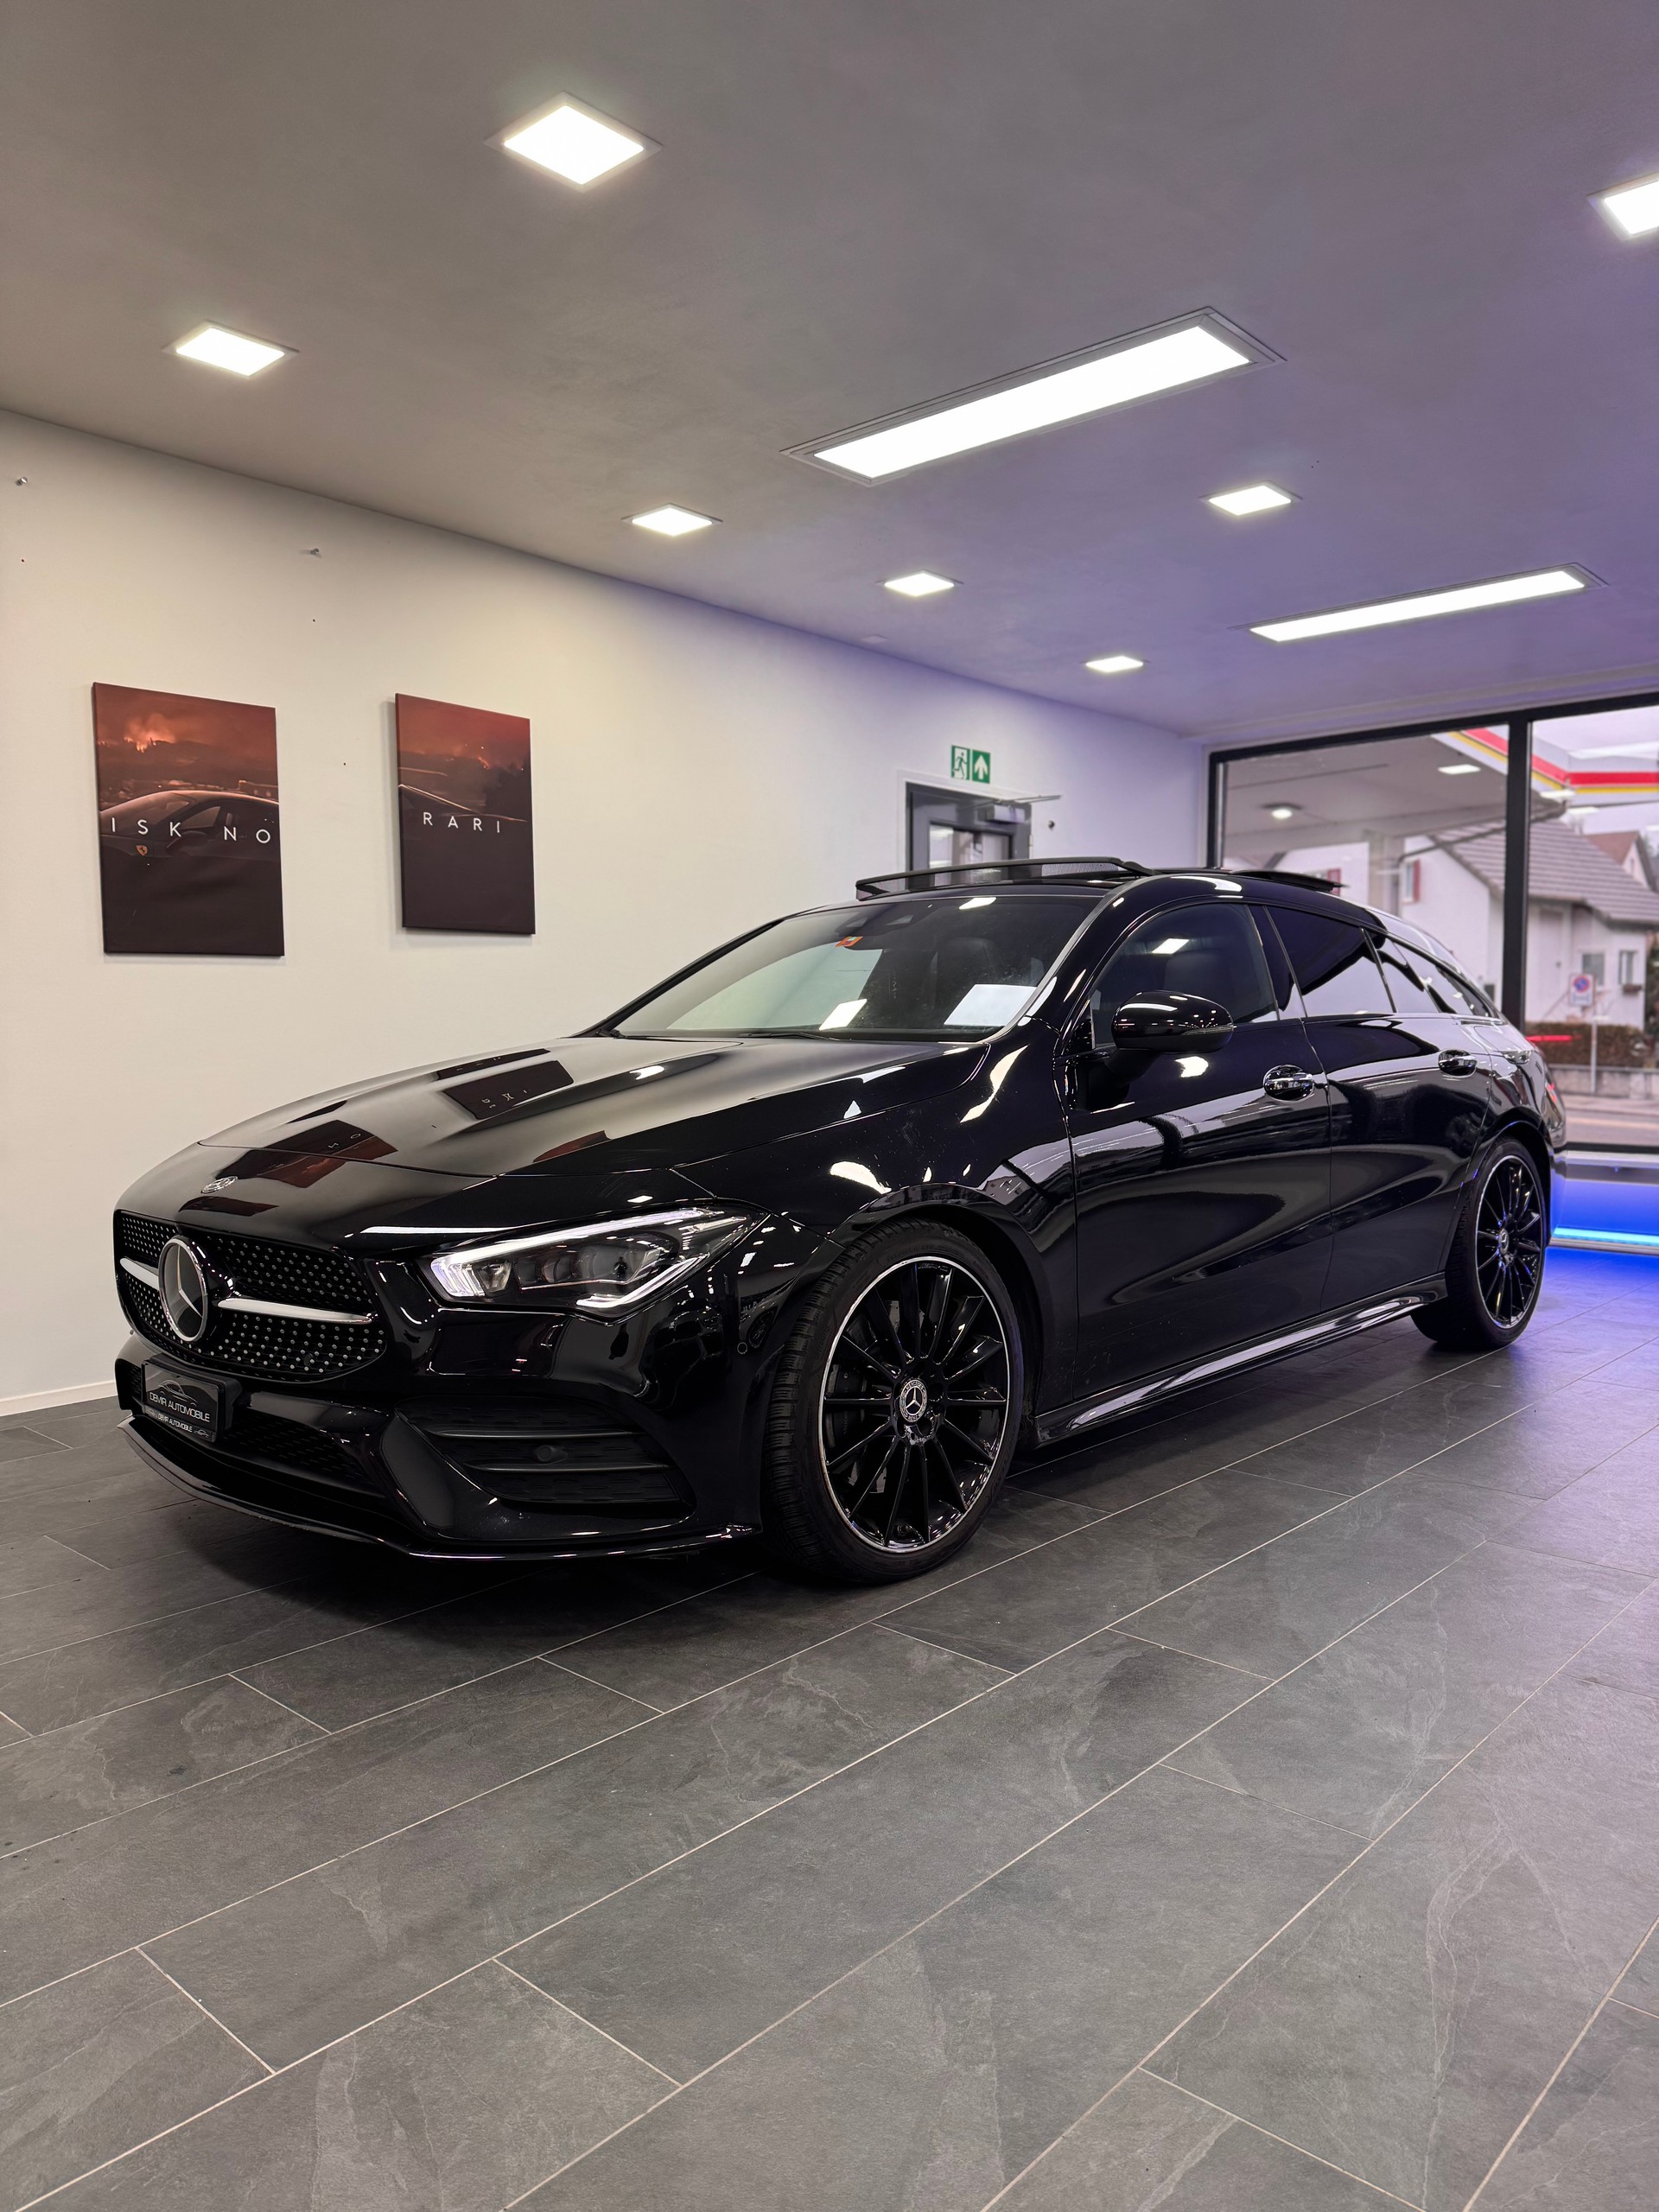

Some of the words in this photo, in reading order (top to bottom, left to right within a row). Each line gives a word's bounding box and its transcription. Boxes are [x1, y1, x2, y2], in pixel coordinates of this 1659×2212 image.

[423, 811, 500, 833] RARI
[168, 1400, 210, 1423] AUTOMOBILE
[168, 1418, 193, 1433] AUTOMOBILE
